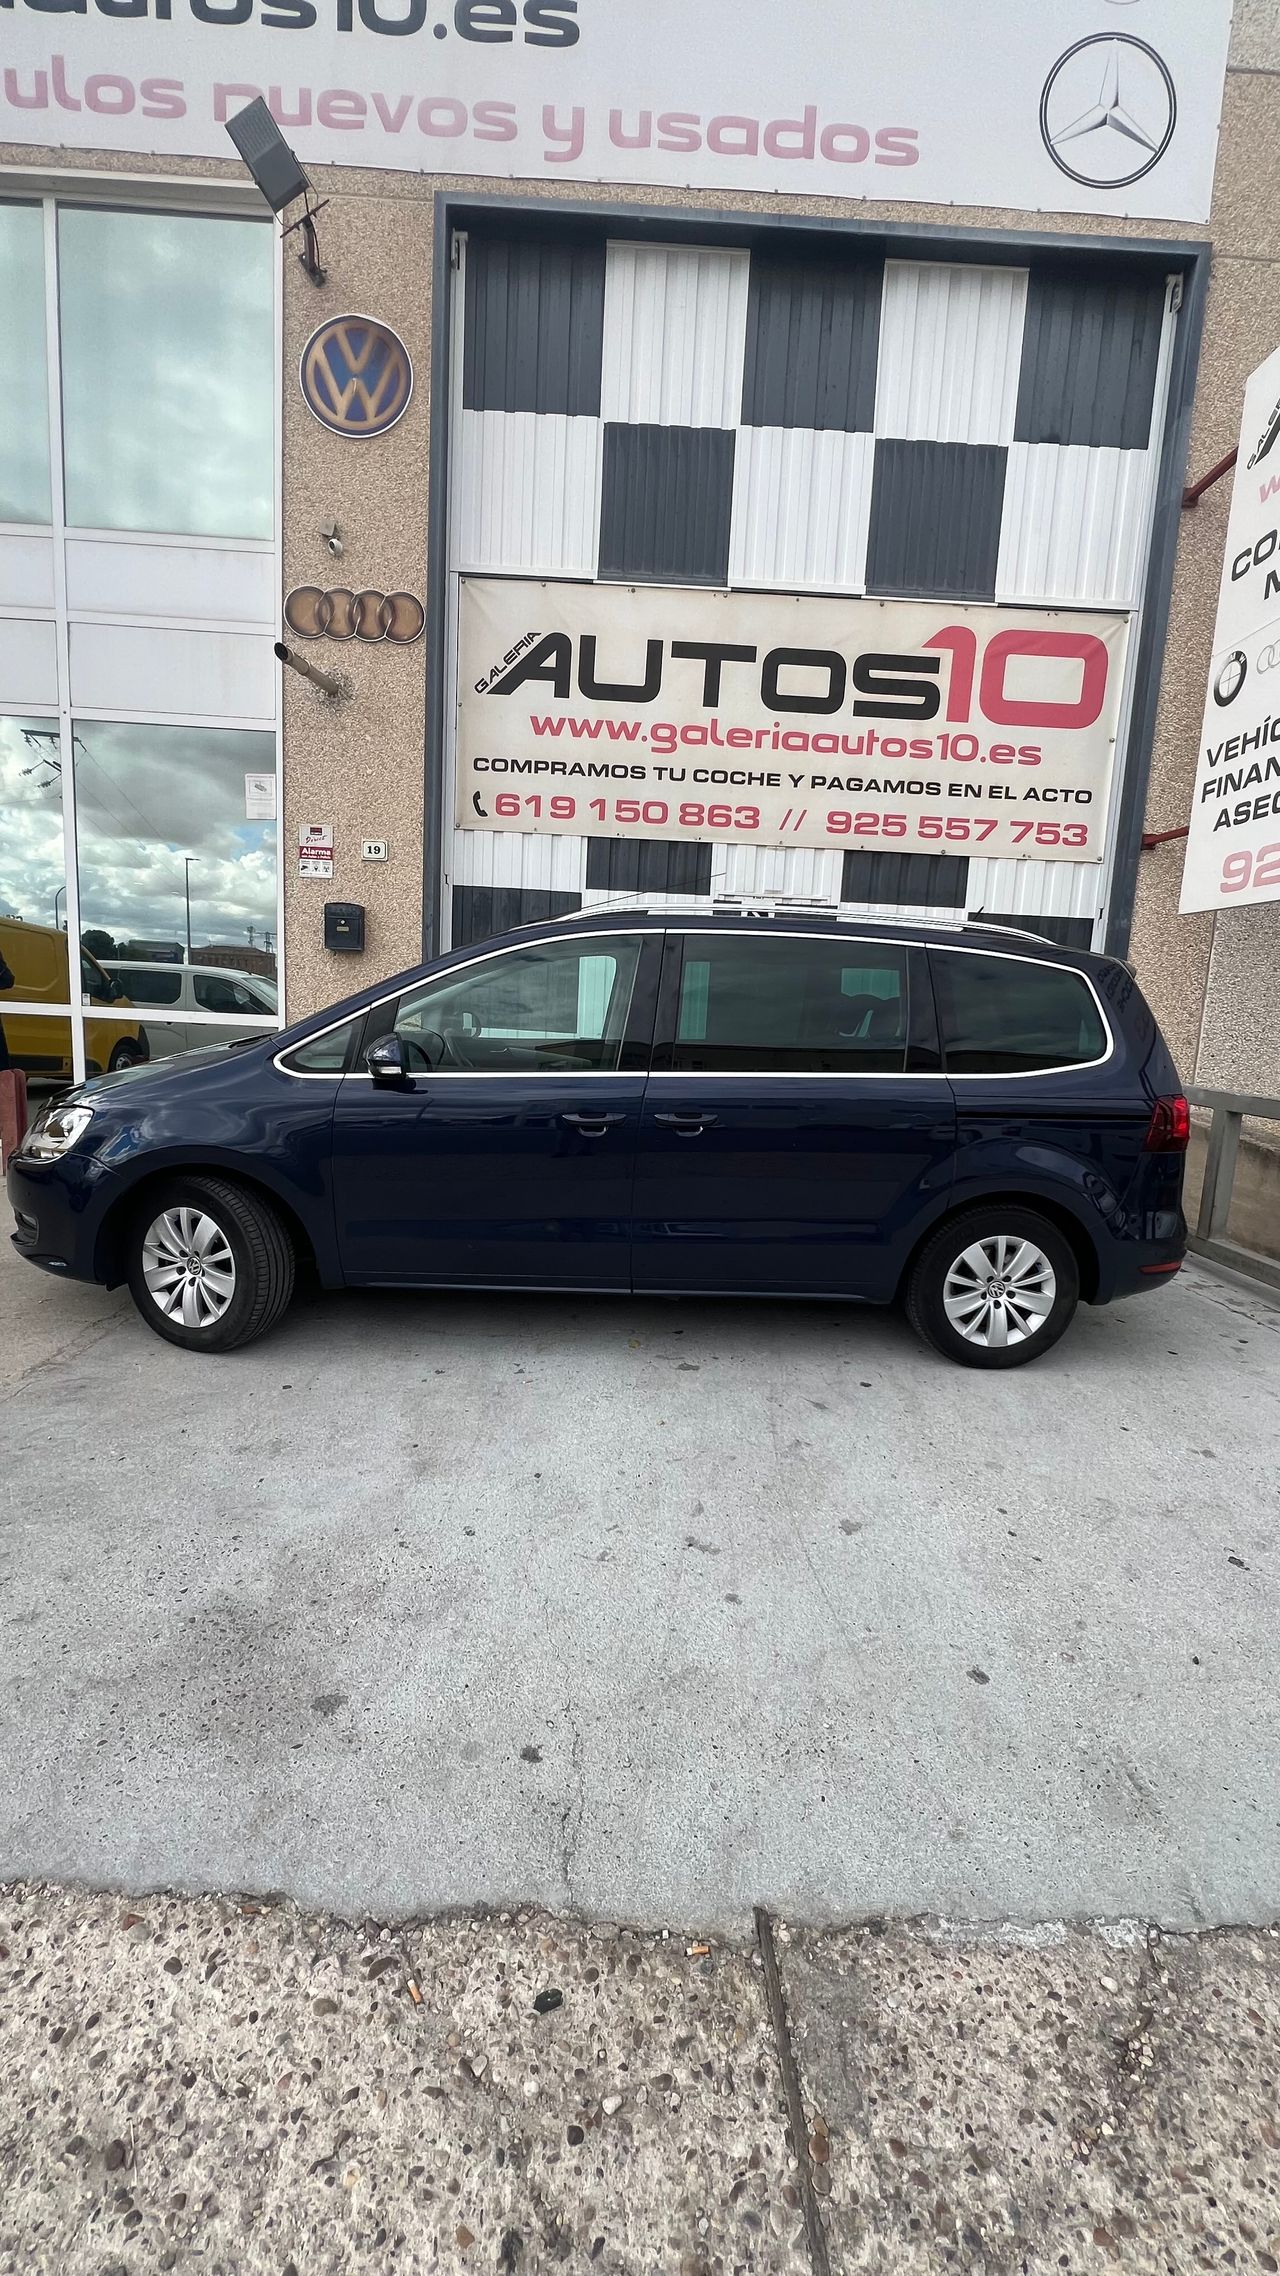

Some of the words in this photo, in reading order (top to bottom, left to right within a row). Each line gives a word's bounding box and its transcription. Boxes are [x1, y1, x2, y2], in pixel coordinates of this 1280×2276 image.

[213, 82, 518, 142] nuevos
[542, 104, 585, 163] y
[608, 105, 920, 167] usados
[1231, 529, 1280, 582] CO
[474, 631, 541, 694] GALERIA
[530, 715, 1042, 766] www.galeriaautos10.es
[473, 757, 646, 780] COMPRAMOS
[653, 766, 686, 782] TU
[693, 768, 781, 788] COCHE
[788, 774, 805, 788] Y
[811, 775, 941, 796] PAGAMOS
[948, 783, 982, 798] EN
[988, 785, 1017, 800] EL
[1022, 787, 1093, 804] ACTO
[495, 793, 576, 819] 619
[589, 798, 668, 825] 150
[679, 803, 760, 830] 863
[826, 811, 907, 837] 925
[917, 816, 998, 842] 557
[1009, 821, 1089, 847] 753
[301, 847, 331, 856] Alarma
[367, 845, 381, 855] 19
[1220, 842, 1280, 894] 92
